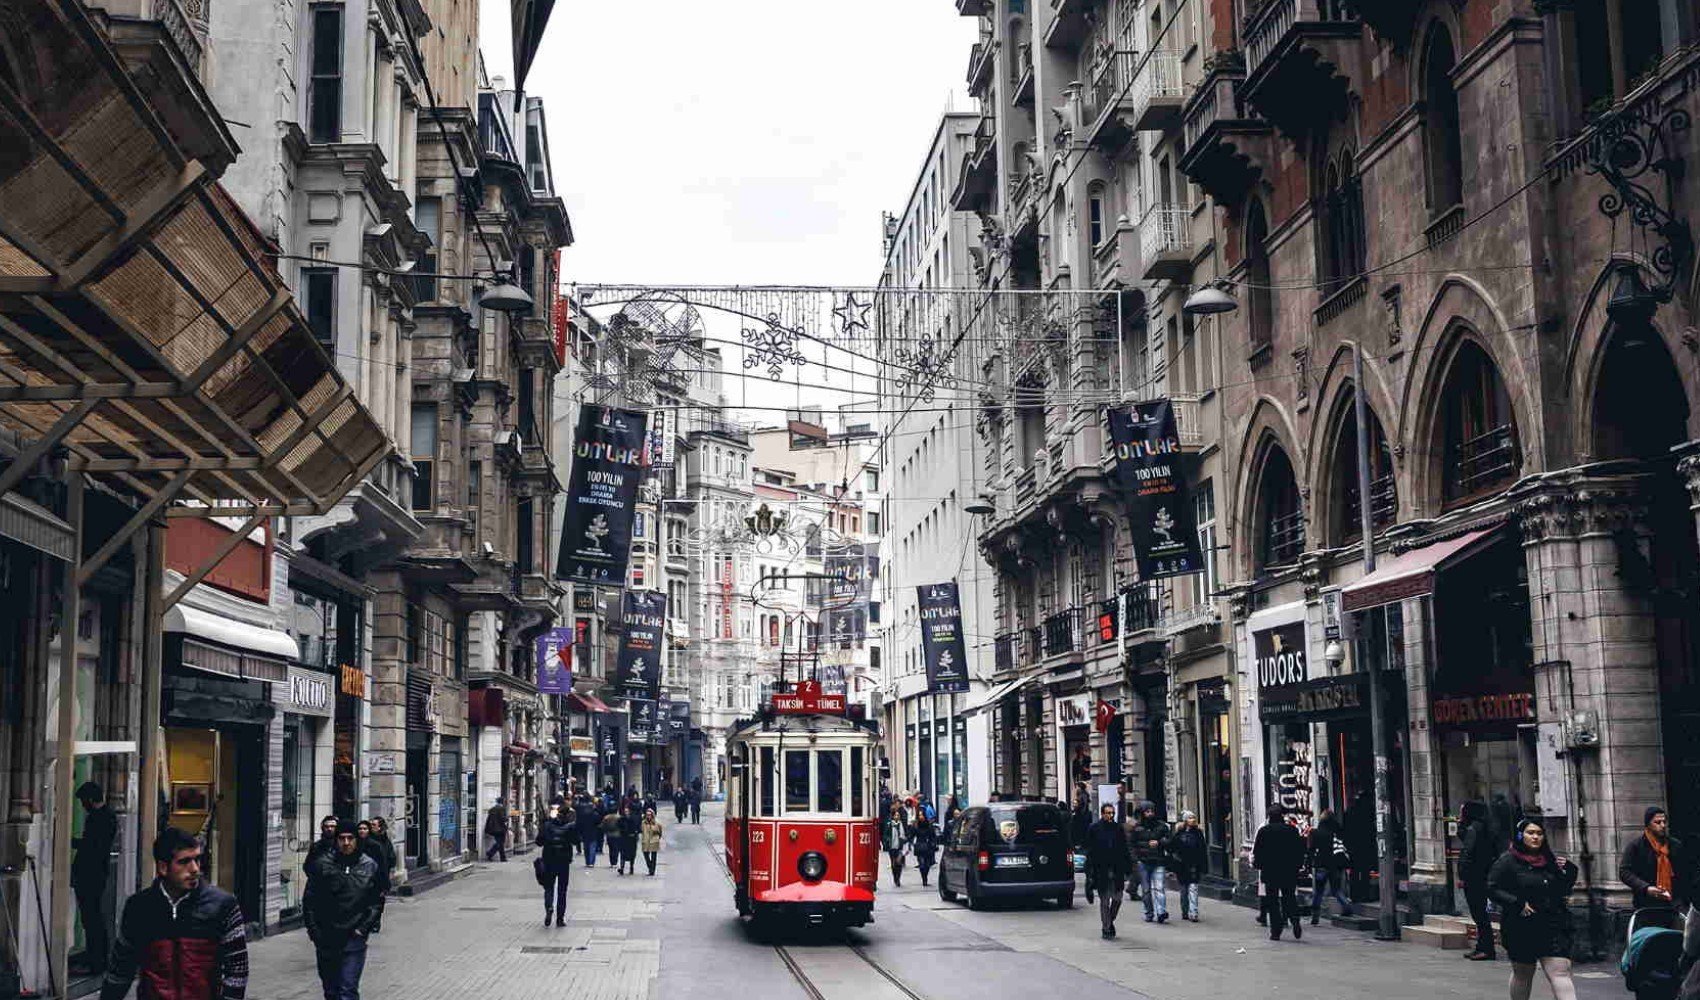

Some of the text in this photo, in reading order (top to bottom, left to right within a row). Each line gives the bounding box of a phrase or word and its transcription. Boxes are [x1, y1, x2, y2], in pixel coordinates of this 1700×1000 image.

[587, 471, 602, 483] 100
[1135, 468, 1150, 480] 100
[805, 681, 812, 691] 2
